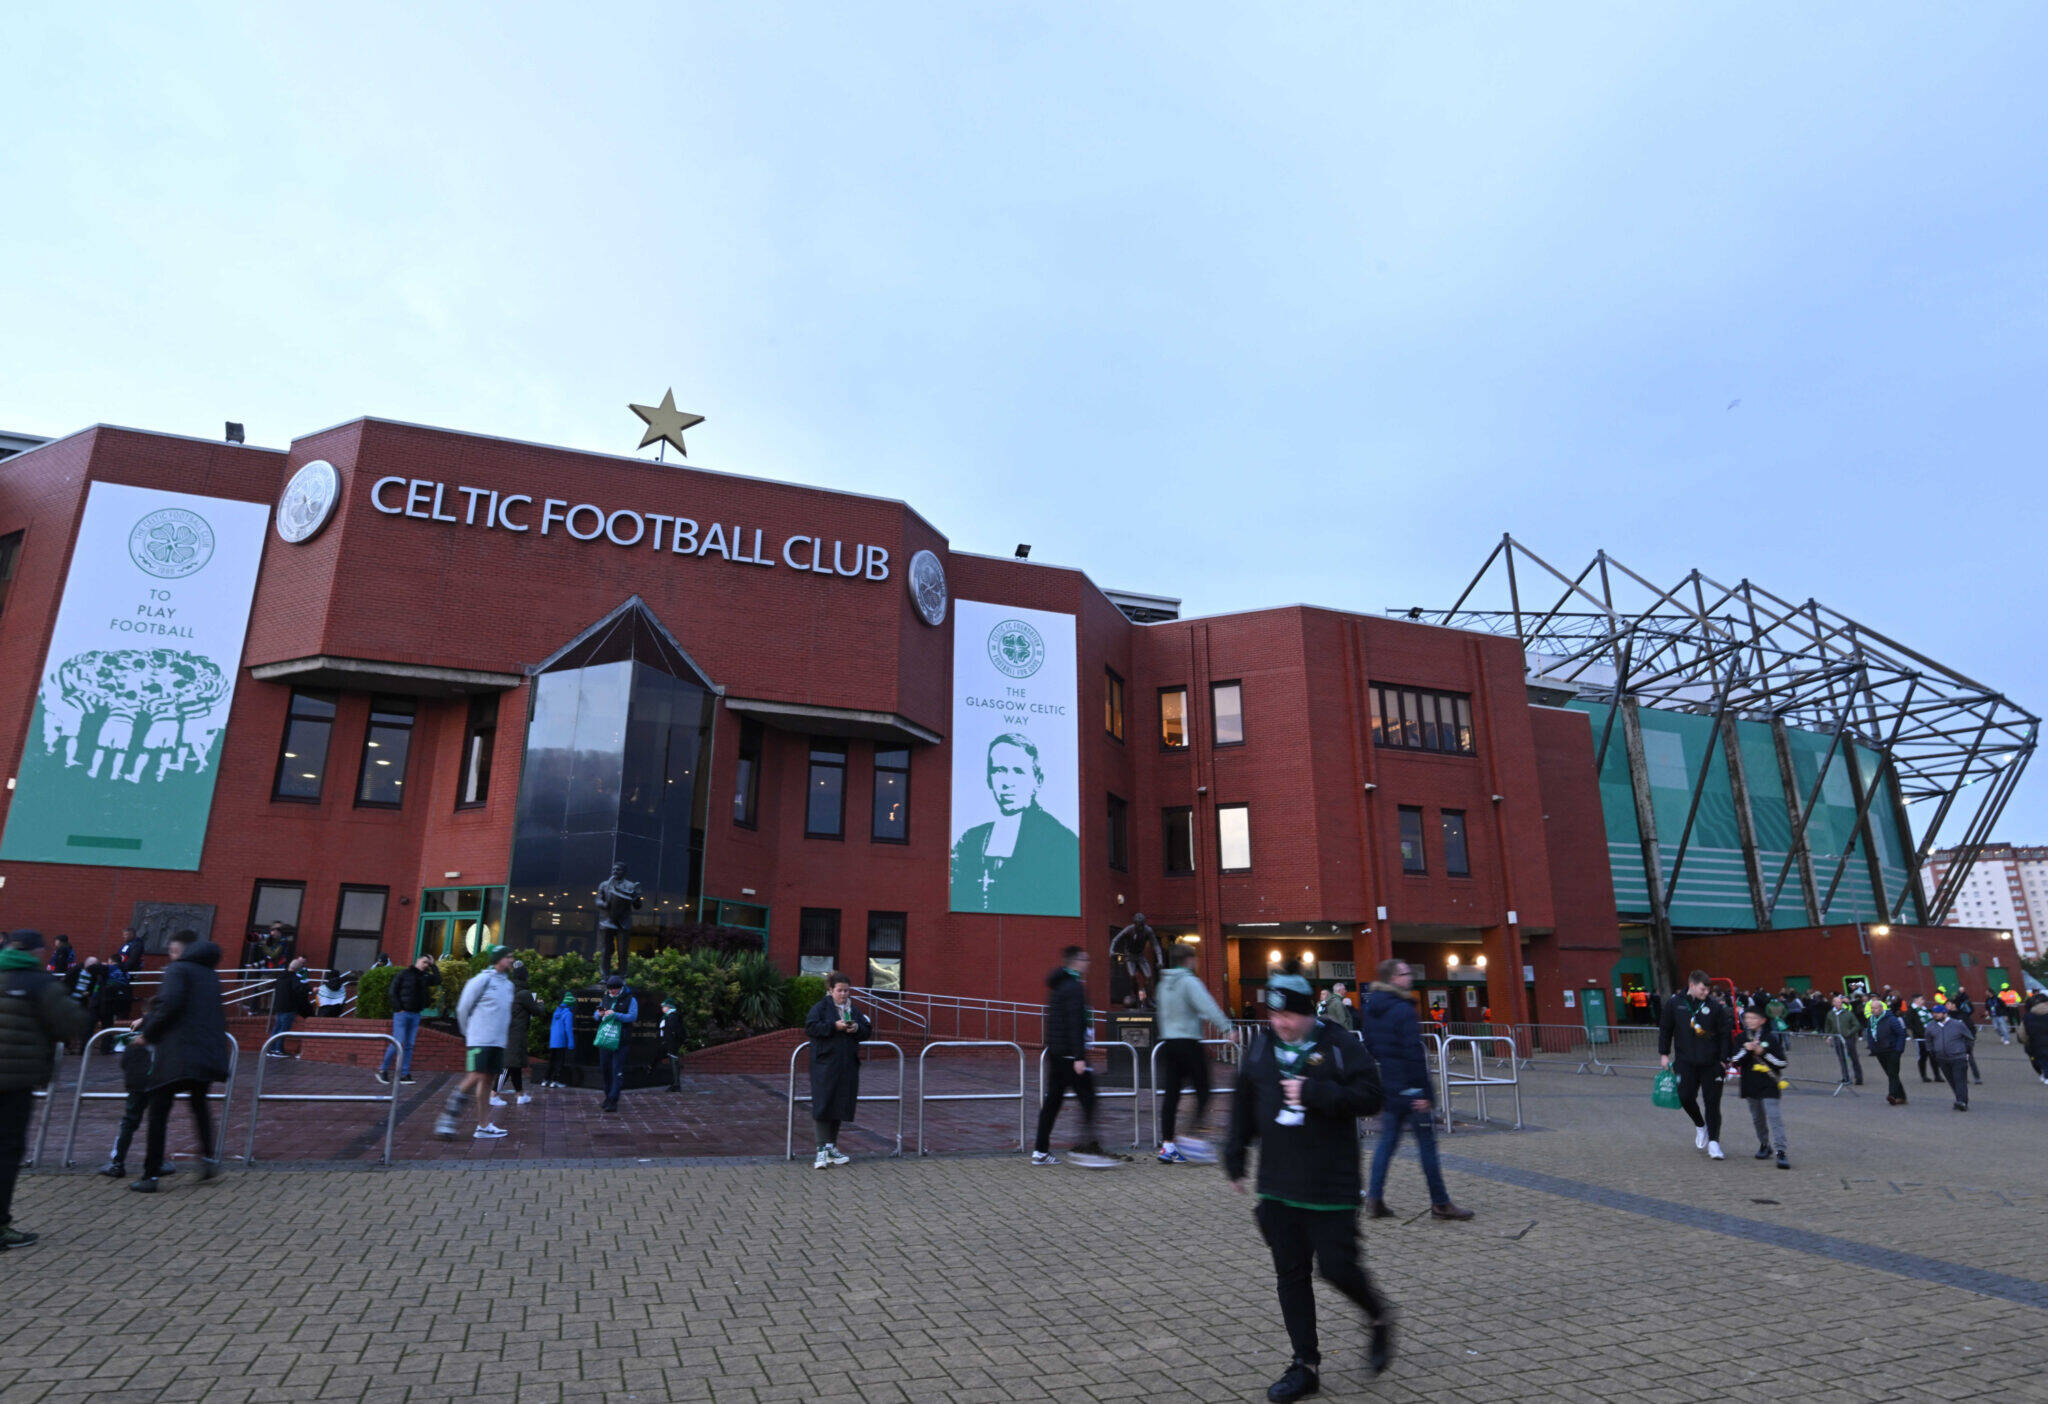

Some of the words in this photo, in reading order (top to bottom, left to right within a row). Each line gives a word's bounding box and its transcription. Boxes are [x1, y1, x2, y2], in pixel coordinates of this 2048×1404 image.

[371, 476, 532, 531] CELTIC
[541, 498, 775, 566] FOOTBALL
[782, 535, 890, 581] CLUB
[150, 589, 171, 601] TO
[137, 605, 176, 619] PLAY
[110, 618, 194, 639] FOOTBALL
[1006, 687, 1026, 697] THE
[966, 696, 1026, 711] GLASGOW
[1029, 703, 1066, 716] CELTIC
[1004, 715, 1029, 725] WAY
